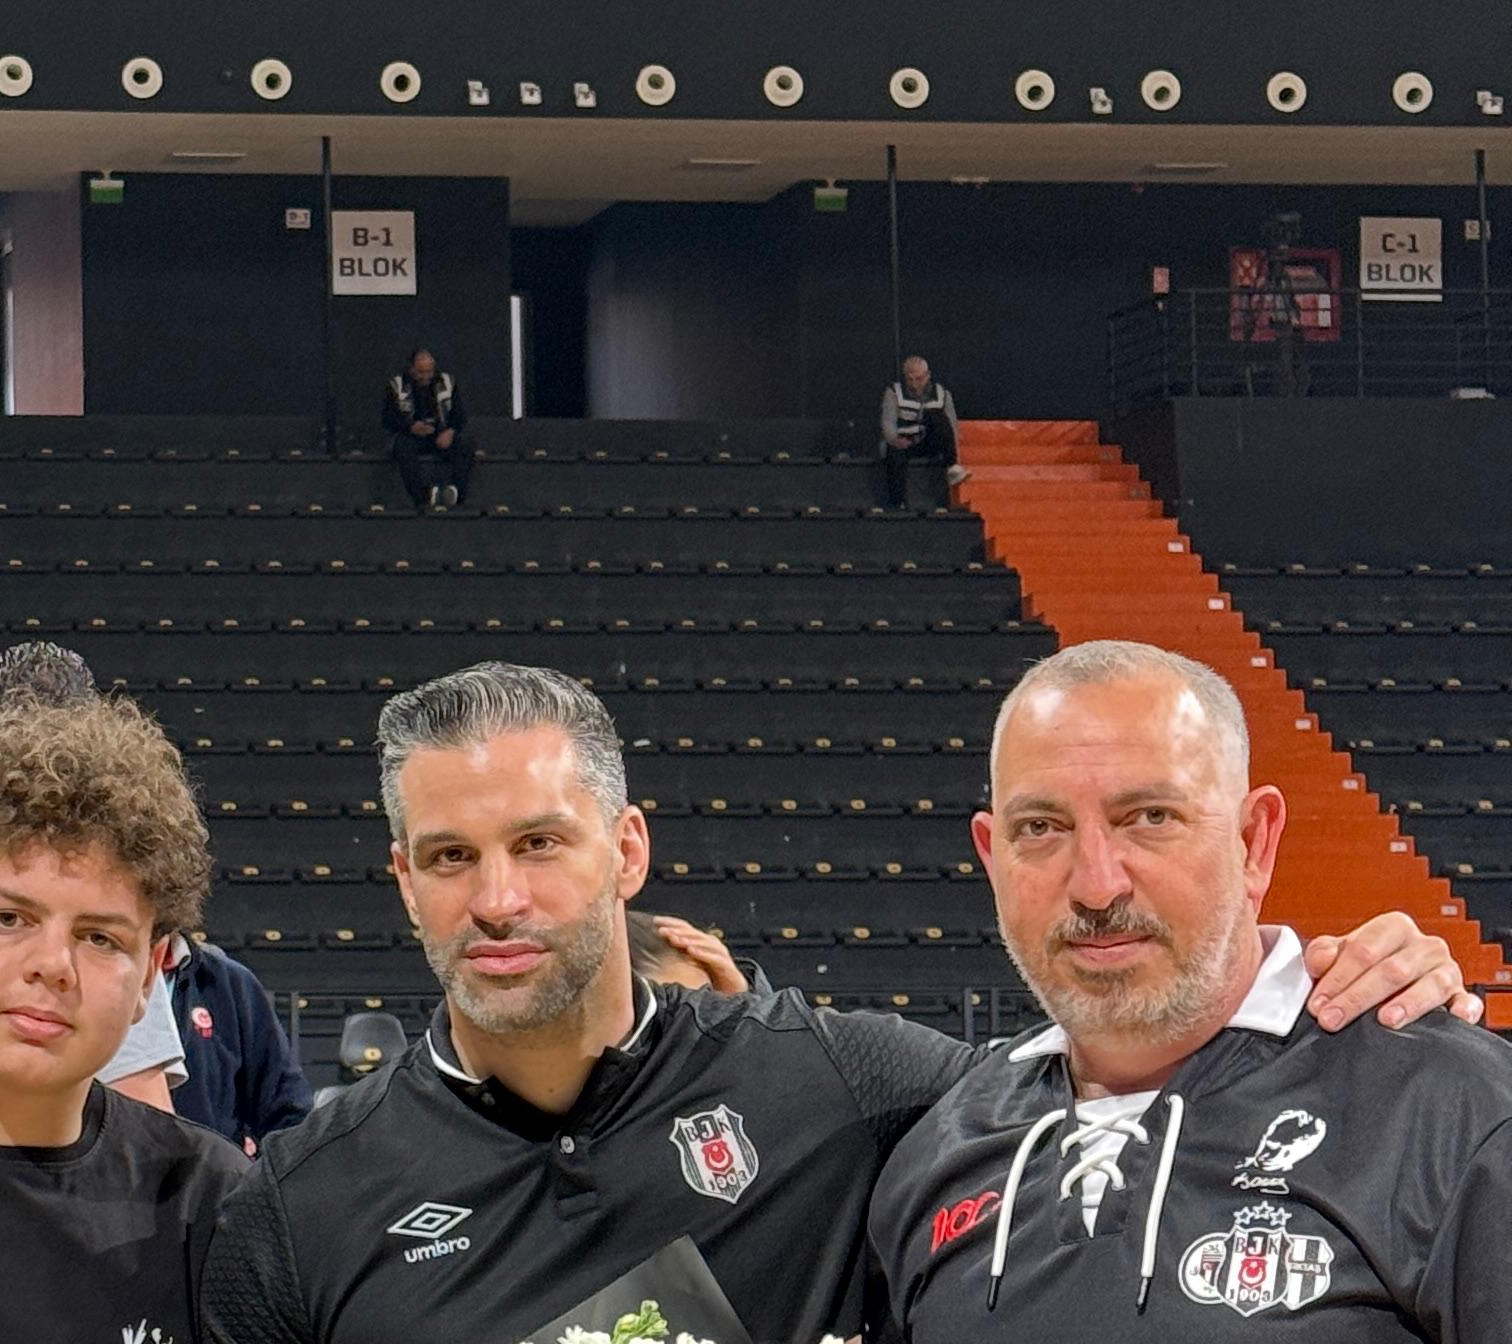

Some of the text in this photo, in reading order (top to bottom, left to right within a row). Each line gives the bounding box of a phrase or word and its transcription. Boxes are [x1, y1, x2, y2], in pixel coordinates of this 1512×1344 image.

[352, 227, 394, 247] B-1
[1381, 233, 1420, 253] C-1
[339, 258, 408, 277] BLOK
[1366, 263, 1435, 283] BLOK
[708, 1170, 748, 1192] 1903
[404, 1234, 471, 1263] umbro
[1234, 1233, 1280, 1256] BJK
[1228, 1288, 1272, 1303] 1903
